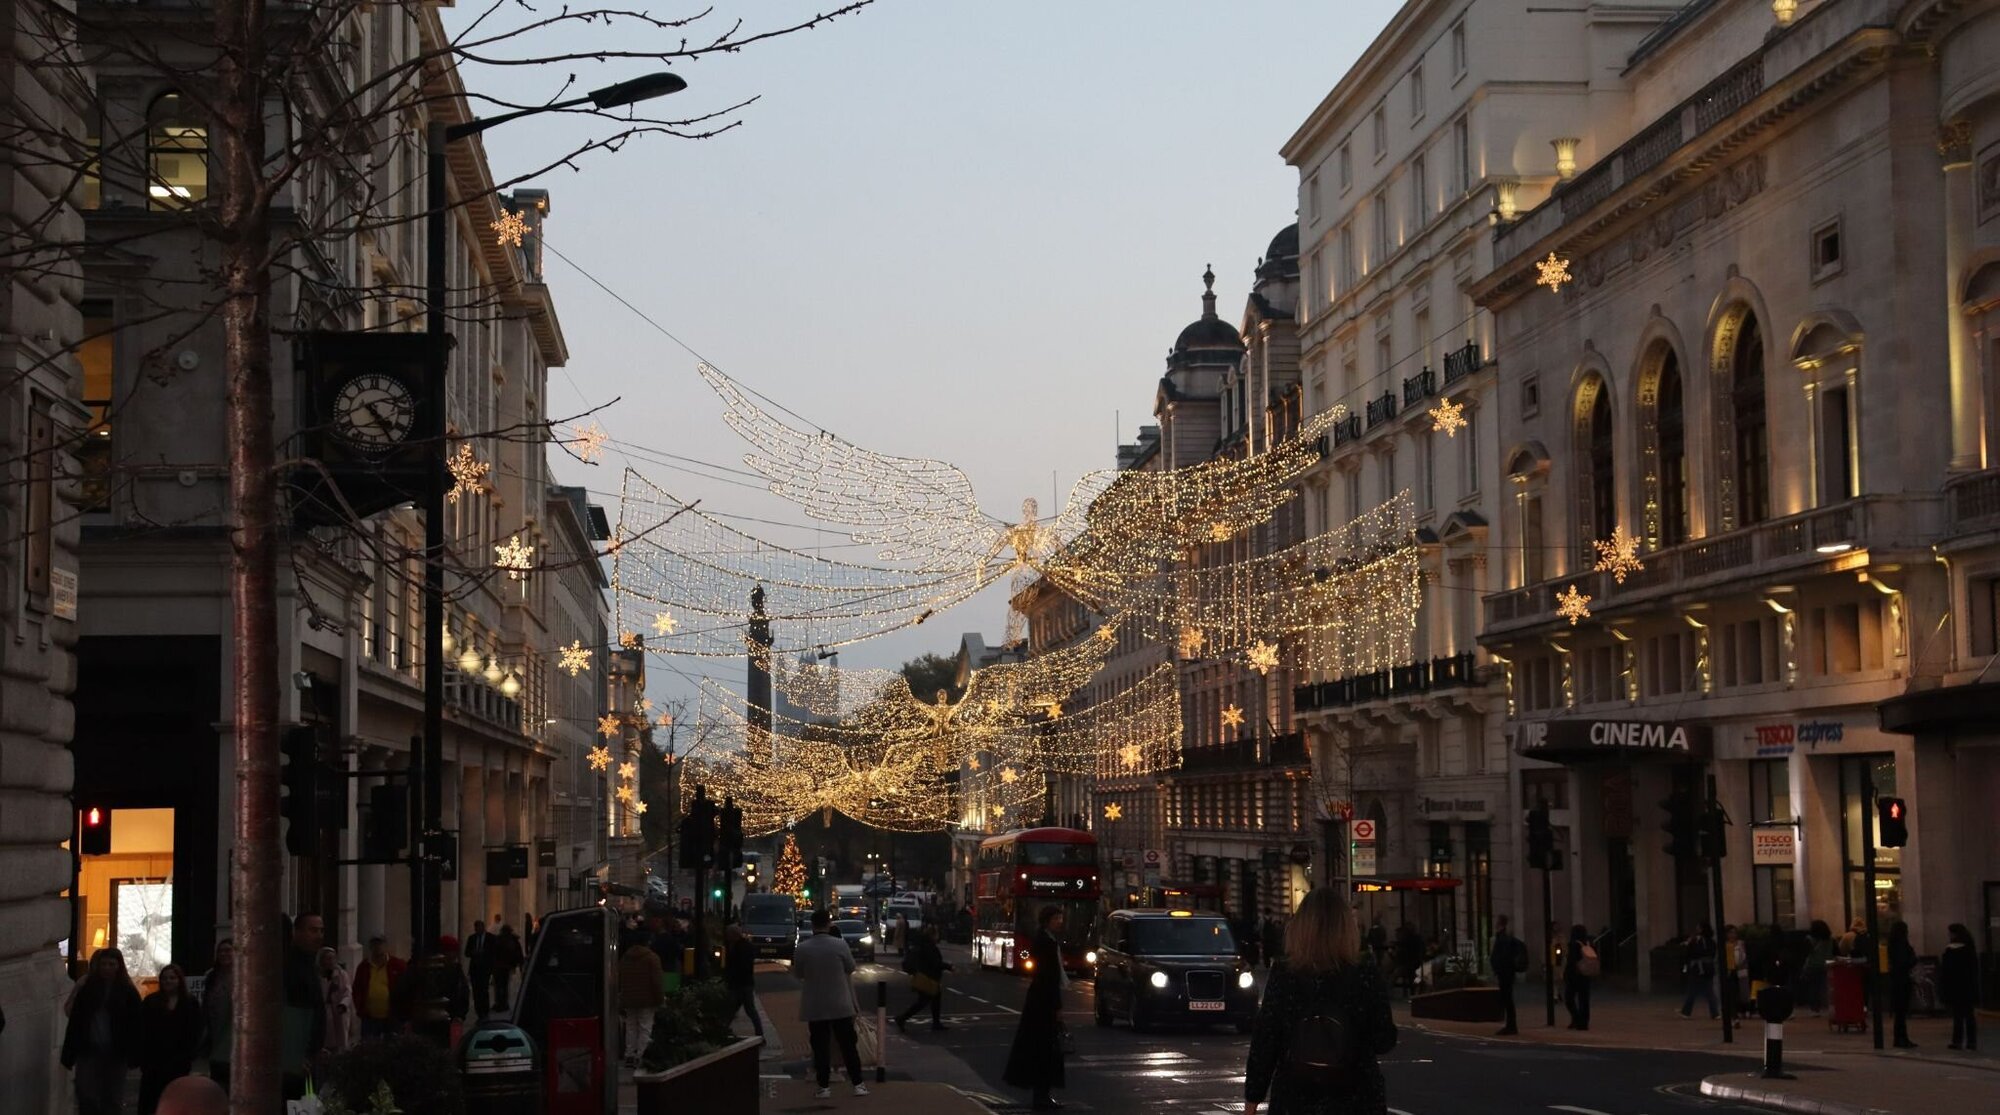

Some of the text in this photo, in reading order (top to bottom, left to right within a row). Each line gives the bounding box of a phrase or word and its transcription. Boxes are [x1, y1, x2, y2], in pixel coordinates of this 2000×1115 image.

[1590, 721, 1690, 750] CINEMA
[1755, 720, 1844, 749] TESCO express
[1756, 835, 1792, 843] TESCO
[1756, 847, 1793, 858] express
[1076, 879, 1084, 889] 9
